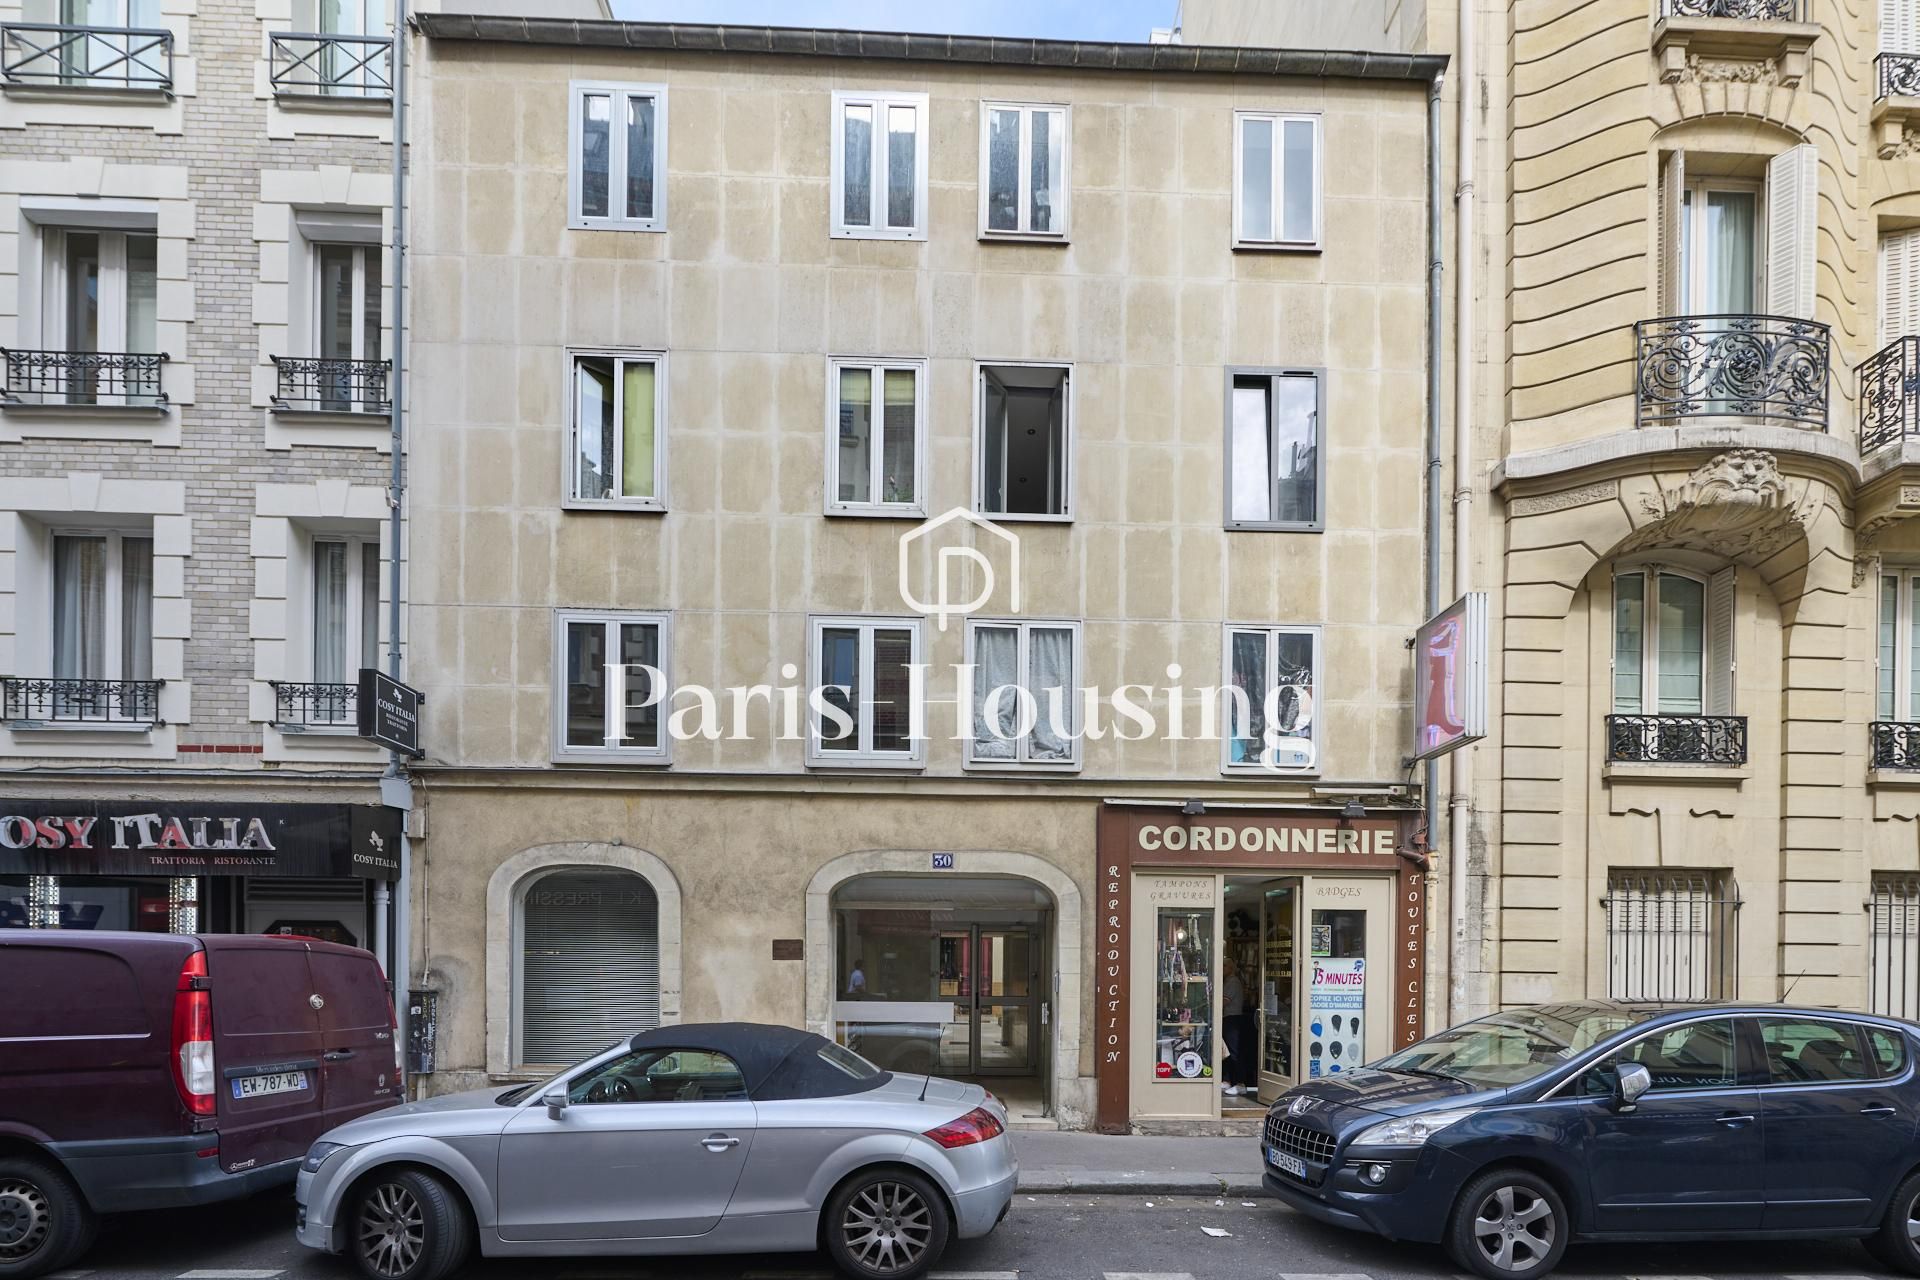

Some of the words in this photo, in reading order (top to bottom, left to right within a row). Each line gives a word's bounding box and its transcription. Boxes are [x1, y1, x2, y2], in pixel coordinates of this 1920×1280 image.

[378, 698, 395, 713] COSY
[395, 705, 415, 723] ITALIA
[109, 813, 277, 851] ITALIA
[1138, 825, 1394, 855] CORDONNERIE
[150, 856, 206, 865] TRATTORIA
[214, 856, 277, 865] RISTORANTE
[353, 853, 375, 865] COSY
[375, 857, 398, 869] ITALIA
[934, 855, 952, 867] 30
[1154, 880, 1208, 889] TAMPONS
[1315, 887, 1362, 899] BADGES
[1150, 891, 1212, 900] GRAVURES
[1407, 874, 1420, 969] TOUTES
[1106, 865, 1121, 1063] REPRODUCTION
[1325, 973, 1363, 985] MINUTES
[1406, 981, 1418, 1042] CLES
[241, 1073, 299, 1094] EW-787-WD
